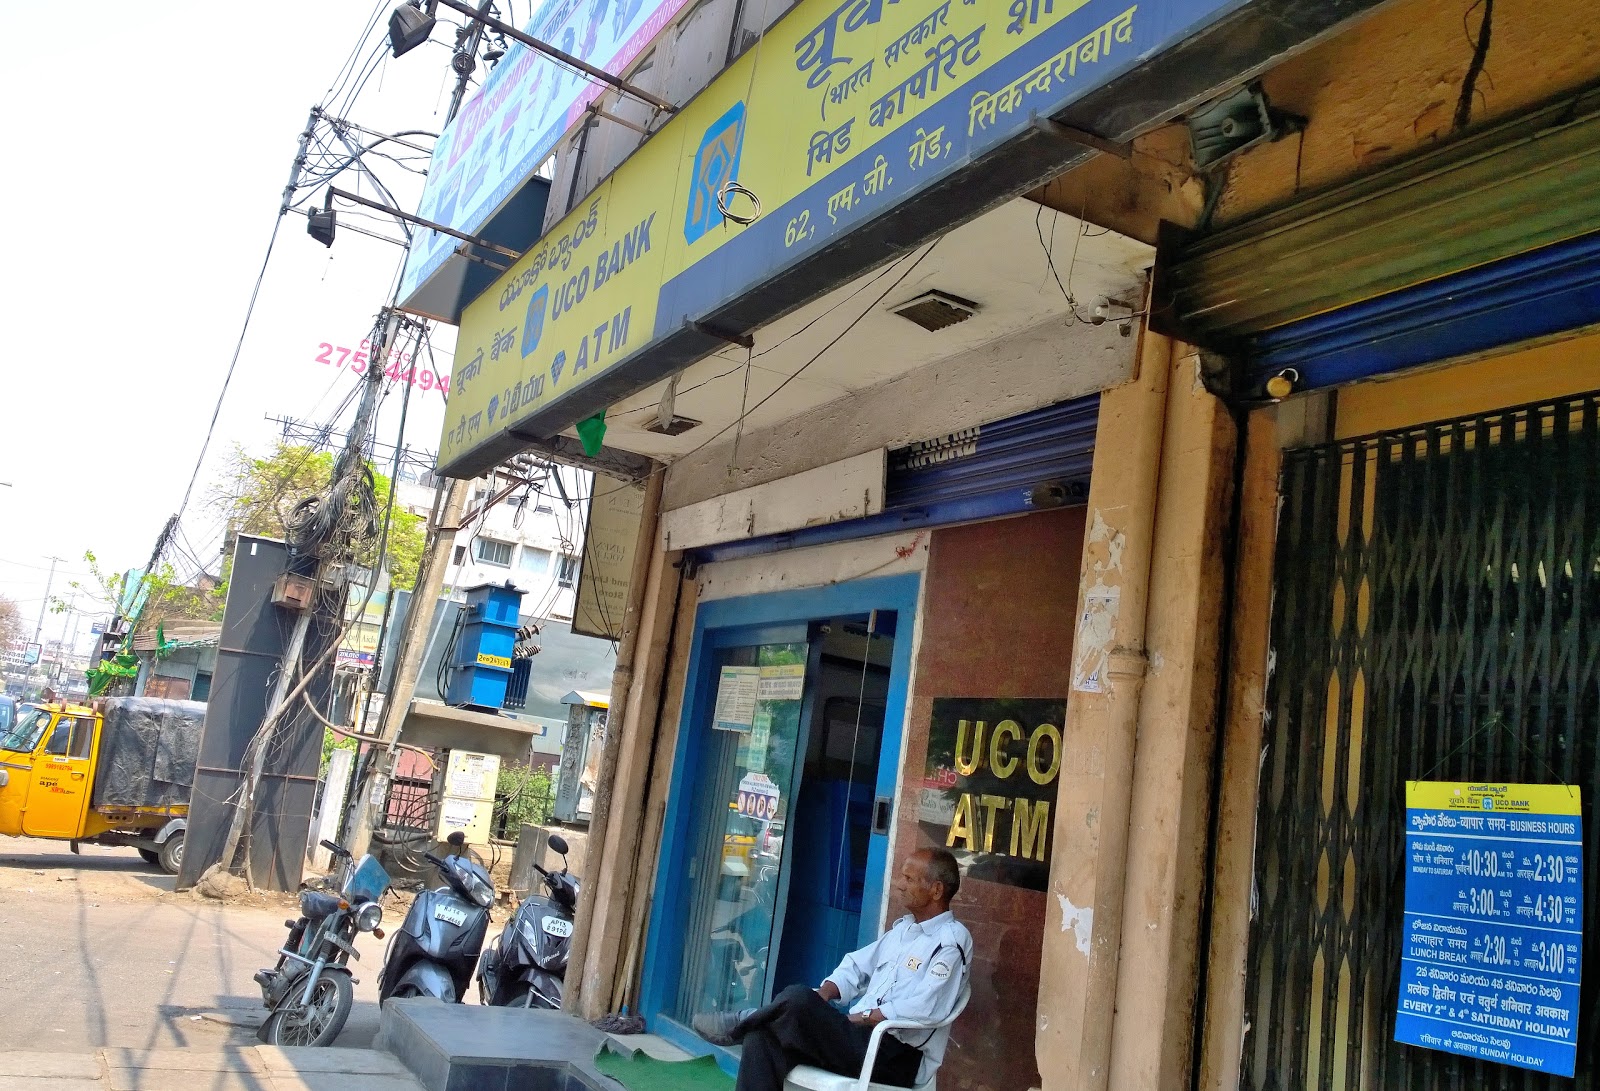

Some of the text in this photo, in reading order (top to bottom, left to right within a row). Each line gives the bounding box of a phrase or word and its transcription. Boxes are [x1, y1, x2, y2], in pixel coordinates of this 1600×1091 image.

[885, 3, 951, 69] सरकार
[806, 117, 856, 176] मिड
[552, 210, 656, 321] UCO BANK
[572, 305, 632, 377] ATM
[315, 342, 450, 395] 2754494
[457, 326, 517, 396] यूको बैंक
[954, 719, 1063, 785] UCO
[945, 793, 1050, 862] ATM
[1548, 822, 1575, 835] HOURS
[1434, 854, 1454, 866] शनिवार
[1467, 849, 1498, 877] 10:30
[1534, 854, 1564, 884] 2:30
[1469, 888, 1494, 916] 3:00
[1535, 894, 1563, 924] 4:30
[1411, 934, 1467, 950] अल्पाहार समय
[1411, 947, 1467, 963] LUNCH BREAK
[1483, 934, 1505, 965] 2:30
[1539, 941, 1564, 974] 3:00
[1407, 981, 1570, 1021] प्रत्येक द्वितीय एवं चतुर्थ शनिवार अवकाश
[1403, 999, 1433, 1013] EVERY
[1448, 1008, 1455, 1017] &
[1471, 1012, 1523, 1029] SATURDAY
[1525, 1021, 1570, 1038] HOLIDAY
[1420, 1033, 1442, 1046] रविवार
[1453, 1041, 1477, 1053] अवकाश
[1480, 1047, 1510, 1060] SUNDAY
[1511, 1053, 1544, 1066] HOLIDAY
